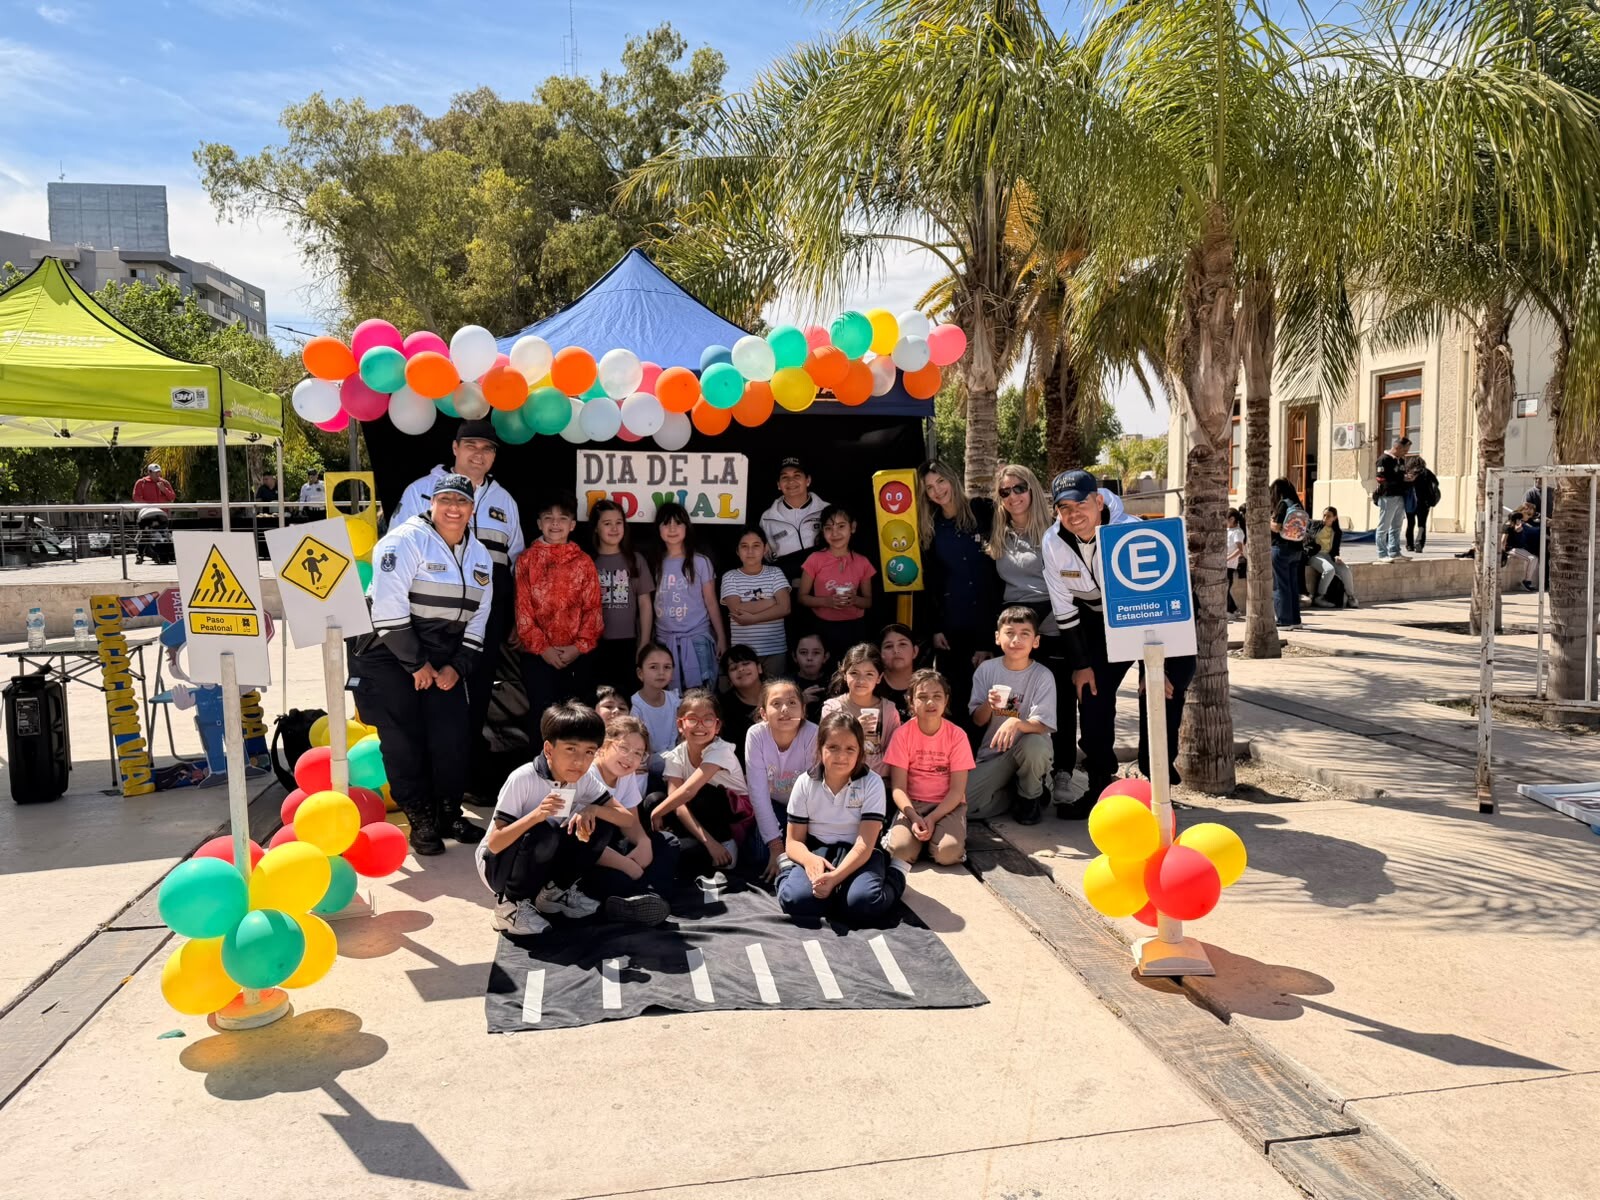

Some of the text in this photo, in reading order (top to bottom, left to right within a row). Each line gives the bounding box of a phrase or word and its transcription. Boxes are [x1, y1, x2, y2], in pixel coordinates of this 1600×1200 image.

[583, 453, 739, 486] DIA DE LA
[1128, 541, 1160, 580] E
[672, 592, 681, 603] is
[1117, 602, 1160, 613] Permitido
[206, 616, 225, 624] Paso
[1116, 610, 1164, 621] Estacionar
[200, 623, 233, 632] Peatonal
[90, 595, 142, 735] EDUCACION
